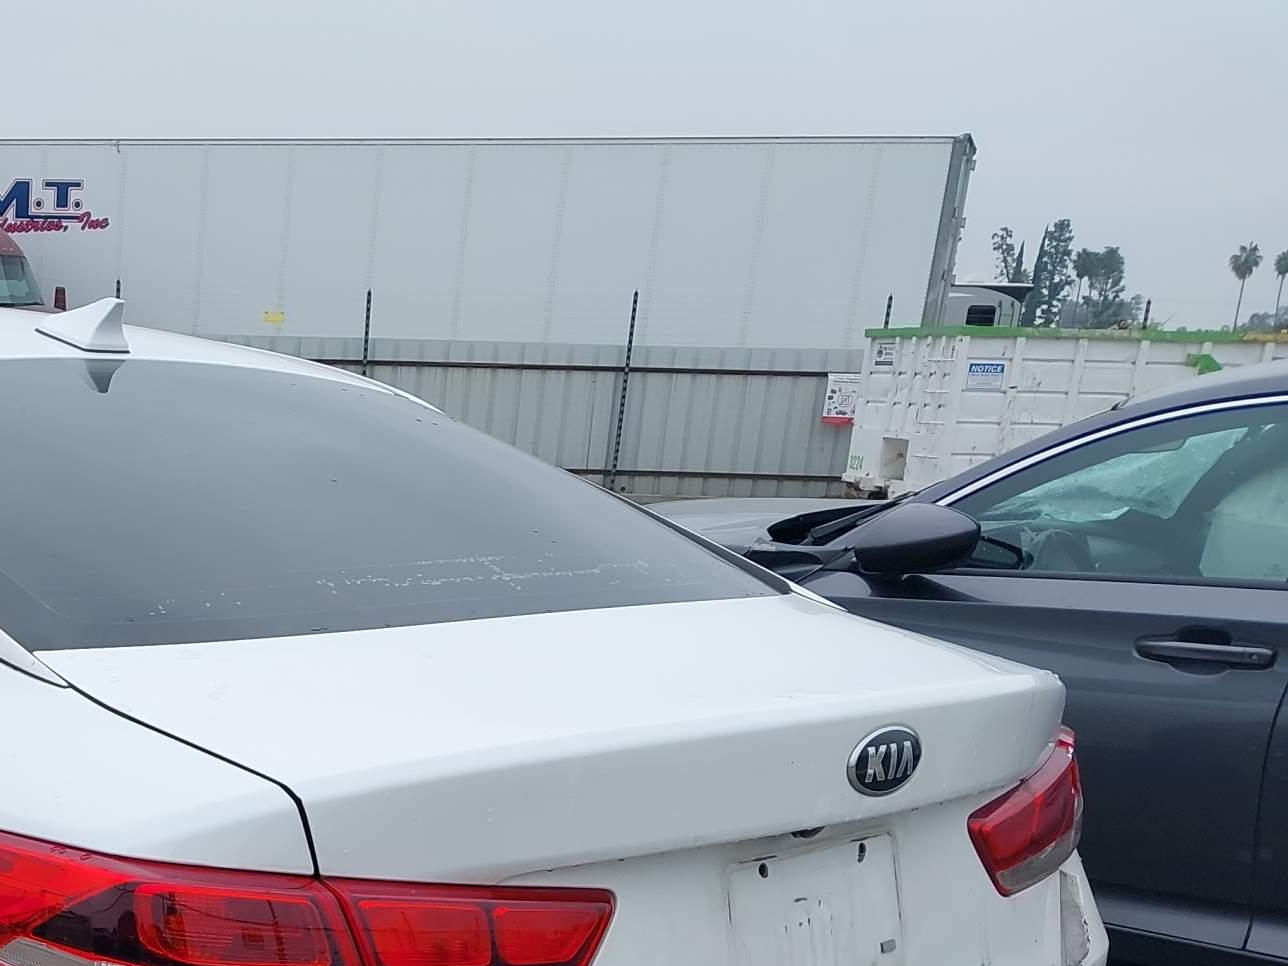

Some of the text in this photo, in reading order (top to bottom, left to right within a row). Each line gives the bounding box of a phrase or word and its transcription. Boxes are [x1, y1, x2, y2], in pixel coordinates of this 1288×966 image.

[78, 212, 109, 231] Inc
[971, 364, 1003, 373] NOTICE
[865, 740, 914, 783] KIA
